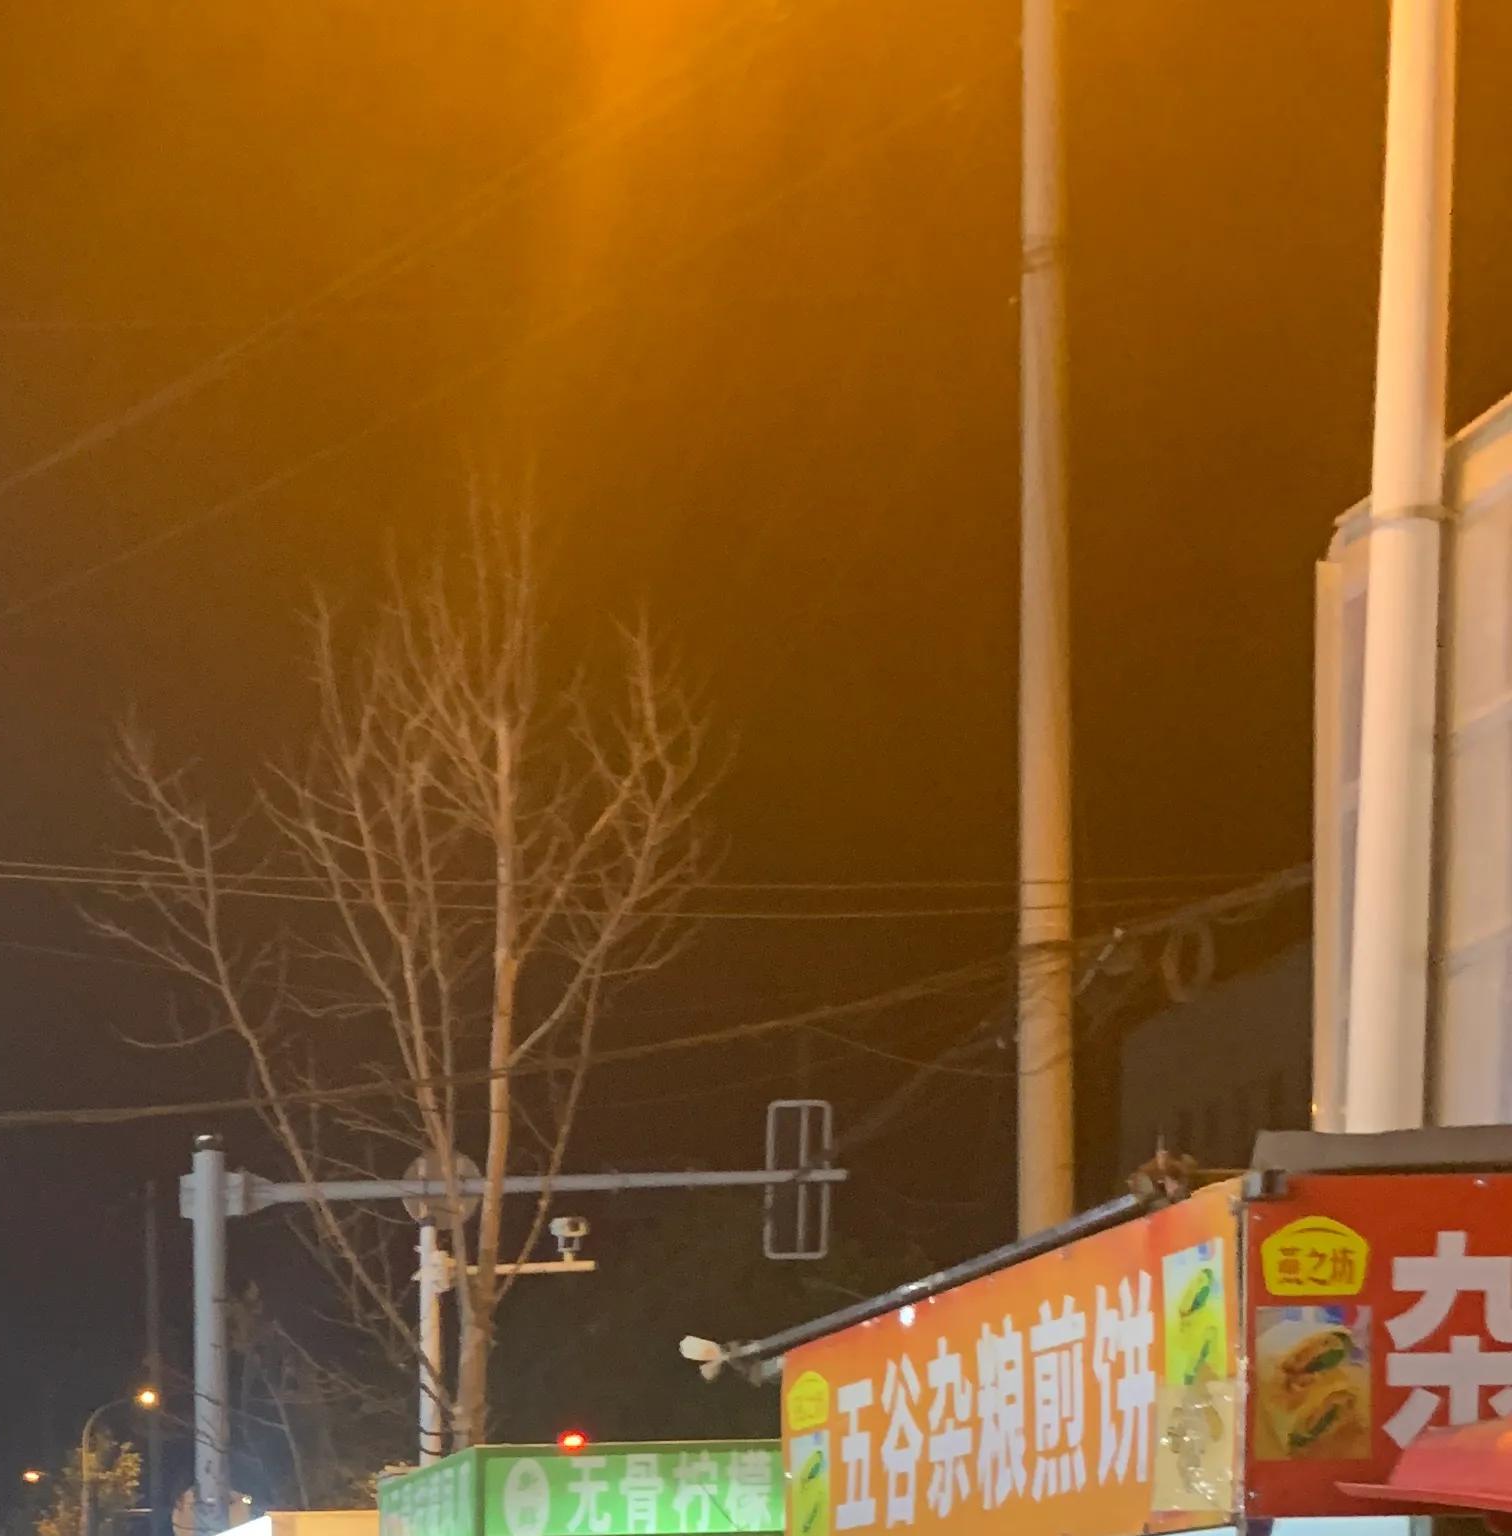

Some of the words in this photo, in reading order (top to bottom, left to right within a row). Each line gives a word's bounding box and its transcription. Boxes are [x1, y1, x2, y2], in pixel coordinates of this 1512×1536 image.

[835, 1269, 1157, 1530] 五谷杂粮煎饼
[567, 1450, 785, 1534] 无骨柠檬
